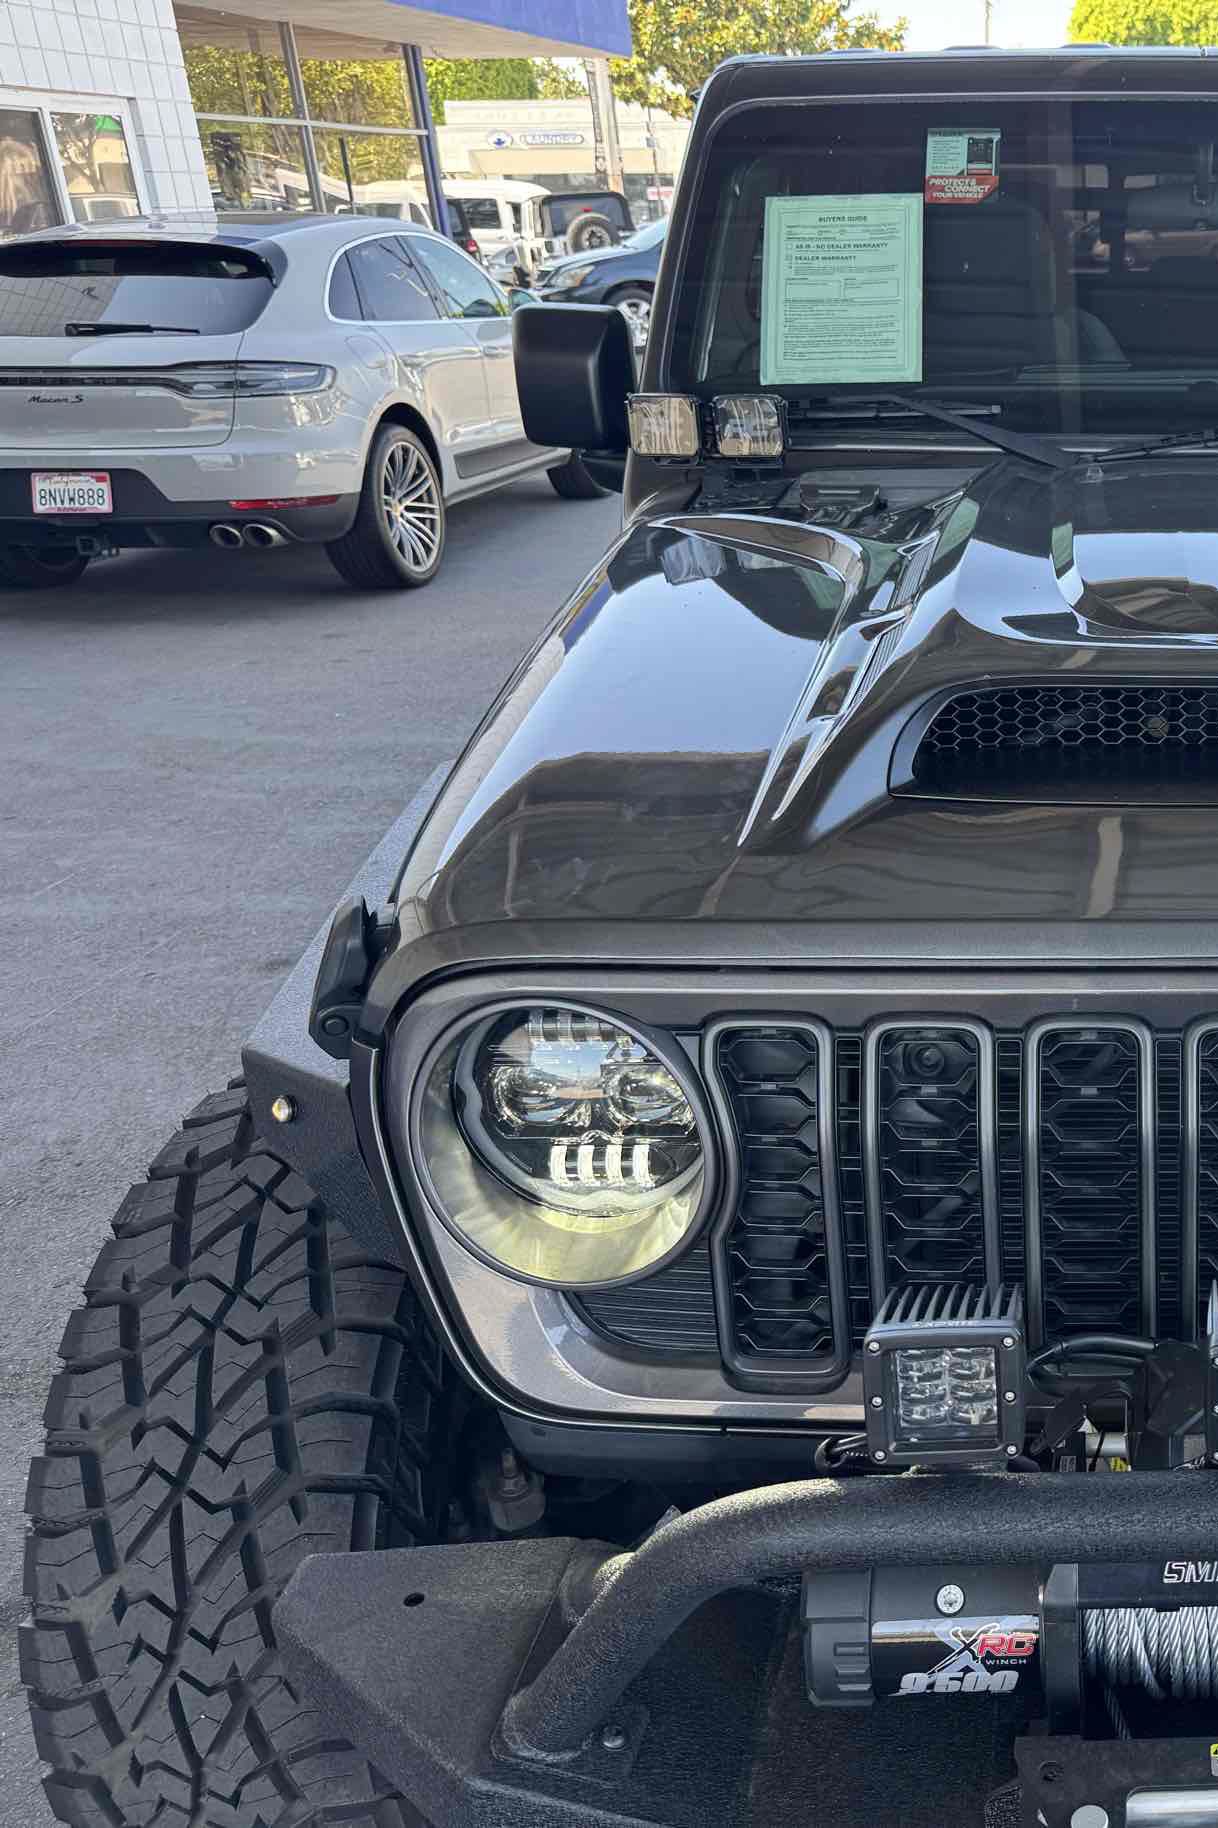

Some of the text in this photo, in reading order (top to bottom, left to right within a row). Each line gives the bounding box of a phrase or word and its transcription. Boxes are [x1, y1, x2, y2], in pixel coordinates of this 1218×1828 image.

[71, 394, 83, 403] S
[39, 488, 105, 506] 8NVW888
[985, 1657, 1027, 1666] WINCH
